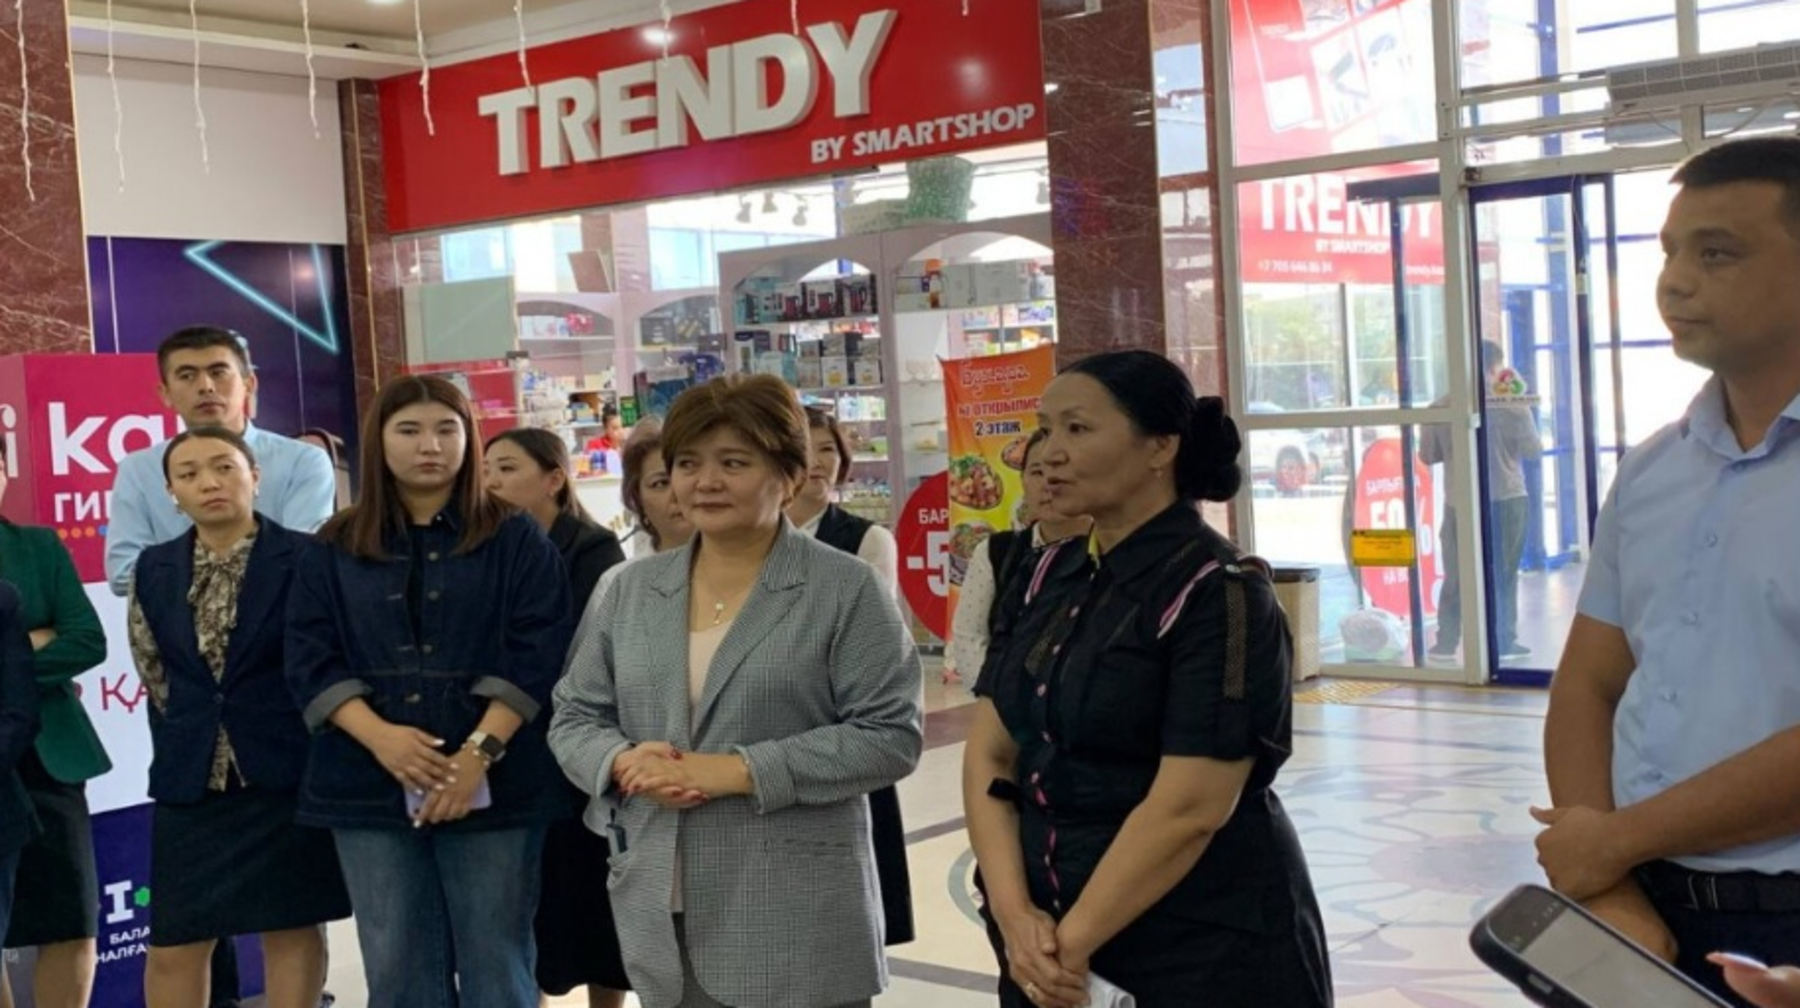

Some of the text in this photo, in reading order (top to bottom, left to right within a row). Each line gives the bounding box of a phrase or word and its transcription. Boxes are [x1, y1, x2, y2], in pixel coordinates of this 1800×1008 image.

[478, 8, 897, 177] TRENDY
[810, 103, 1036, 163] BY SMARTSHOP
[975, 421, 984, 436] 2
